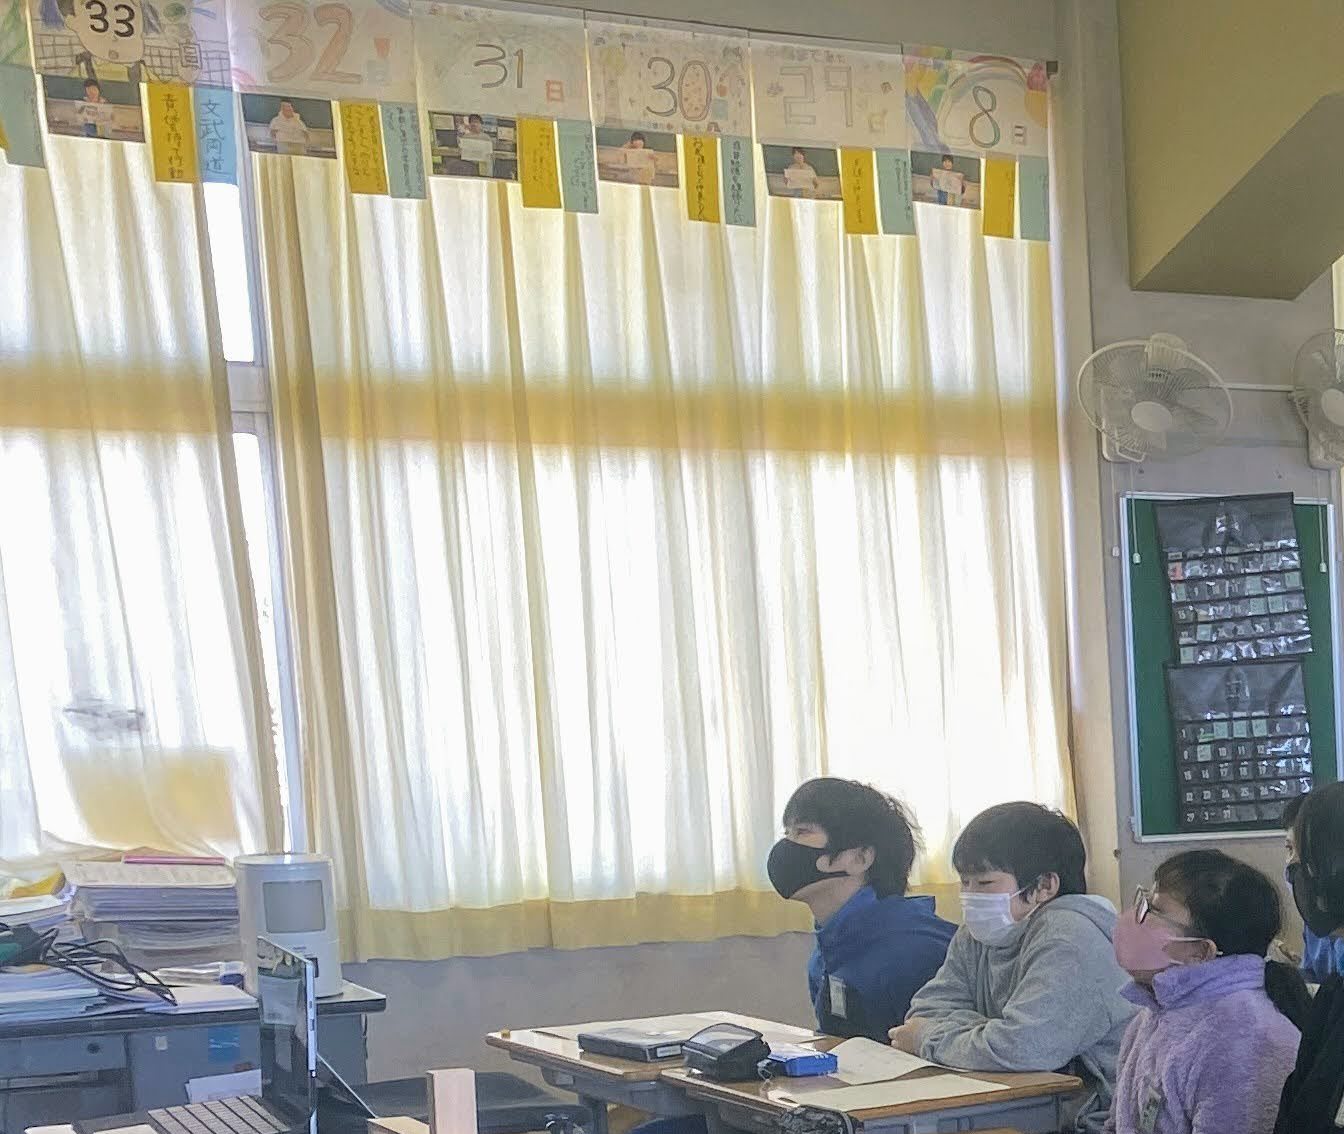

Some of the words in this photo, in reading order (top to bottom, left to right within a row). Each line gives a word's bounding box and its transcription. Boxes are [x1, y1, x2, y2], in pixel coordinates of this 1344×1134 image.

[86, 0, 135, 38] 33
[259, 3, 362, 84] 32
[473, 43, 524, 89] 31
[646, 56, 712, 121] 30
